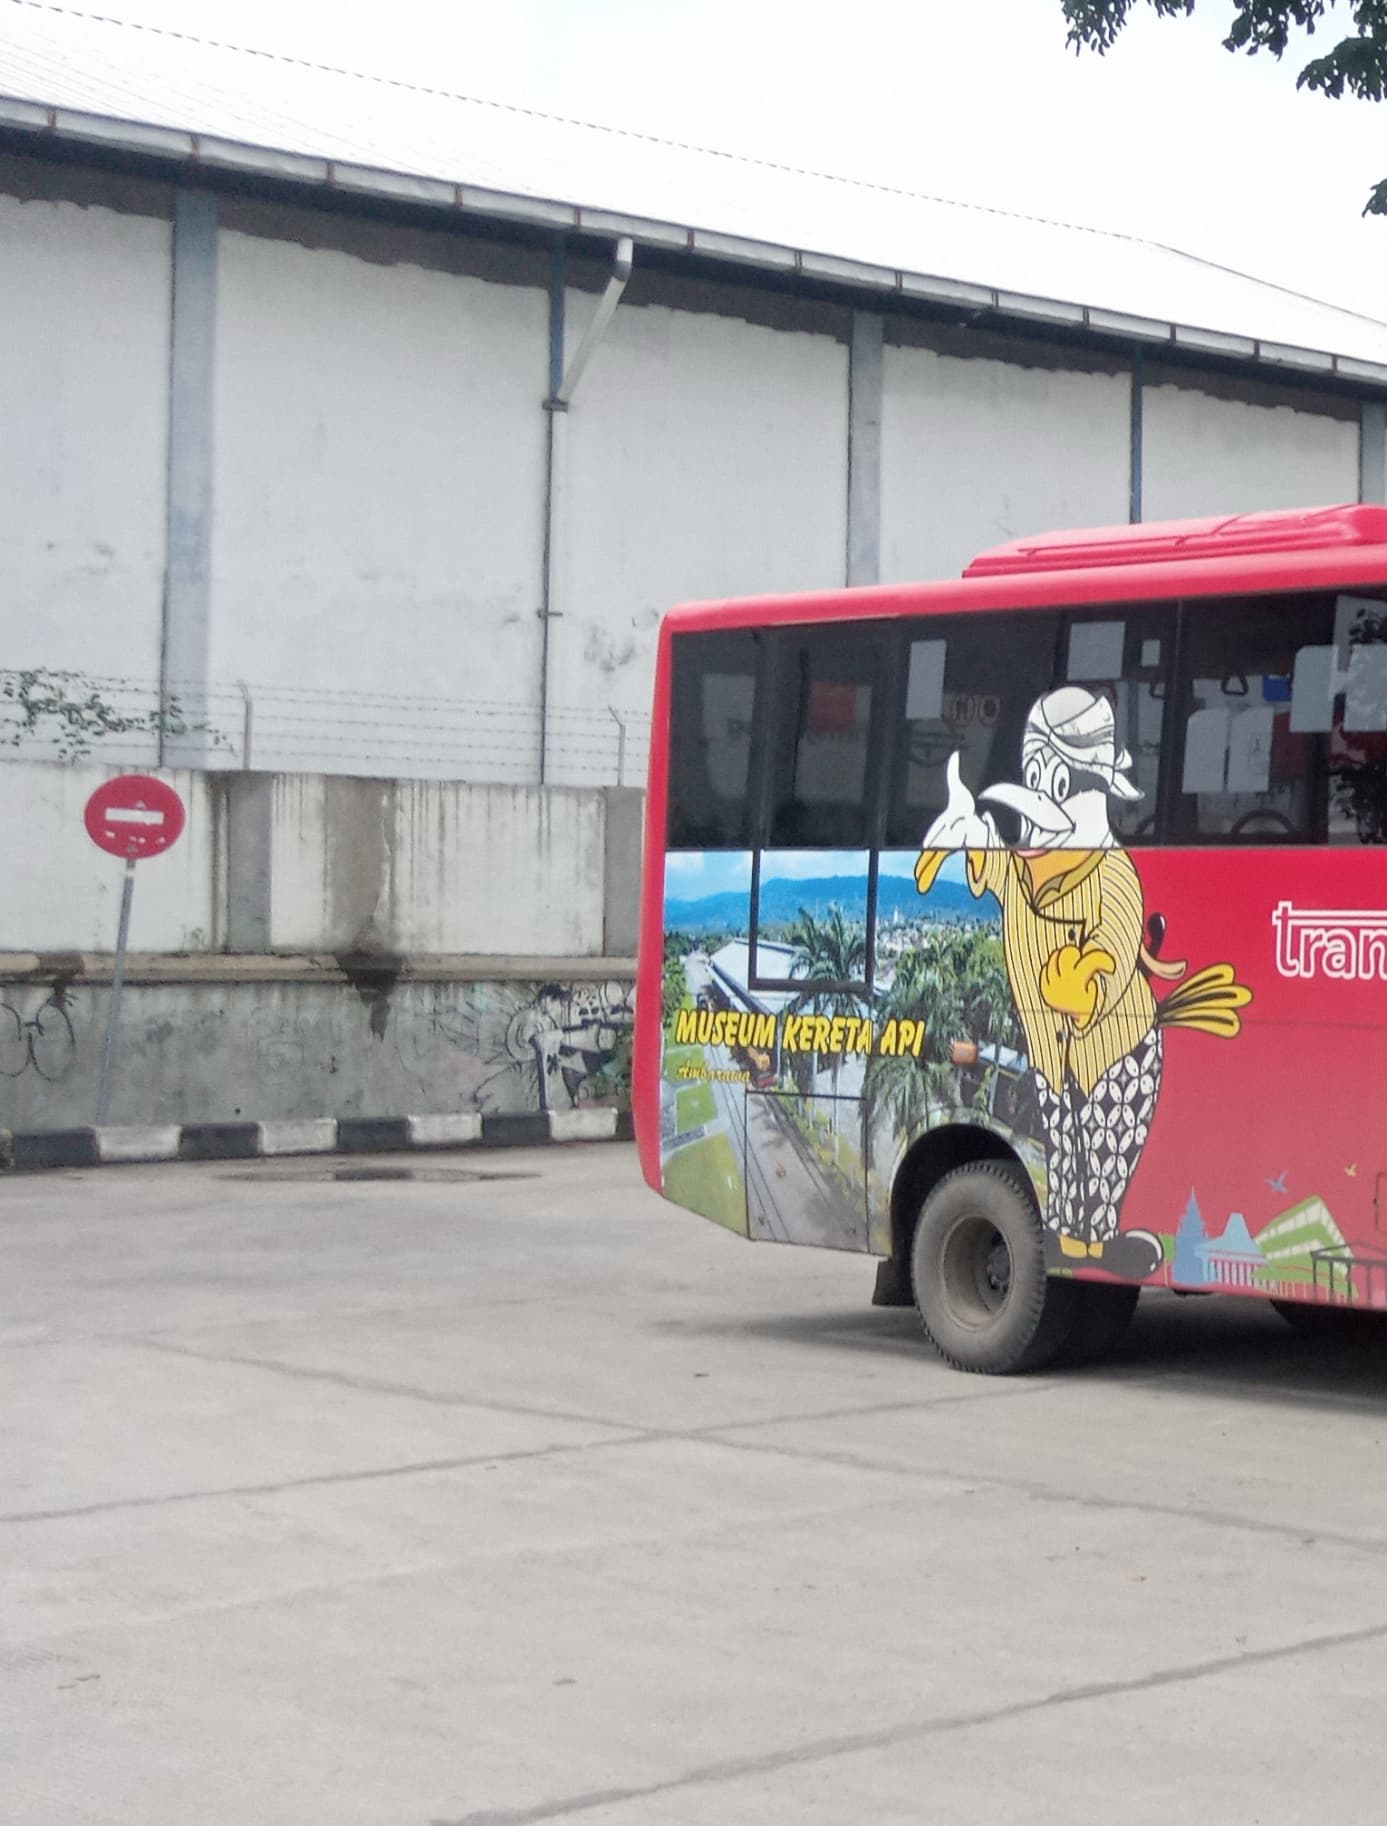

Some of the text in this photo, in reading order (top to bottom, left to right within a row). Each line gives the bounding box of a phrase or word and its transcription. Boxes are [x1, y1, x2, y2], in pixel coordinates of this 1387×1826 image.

[676, 1009, 926, 1057] MUSEUM KERETA API
